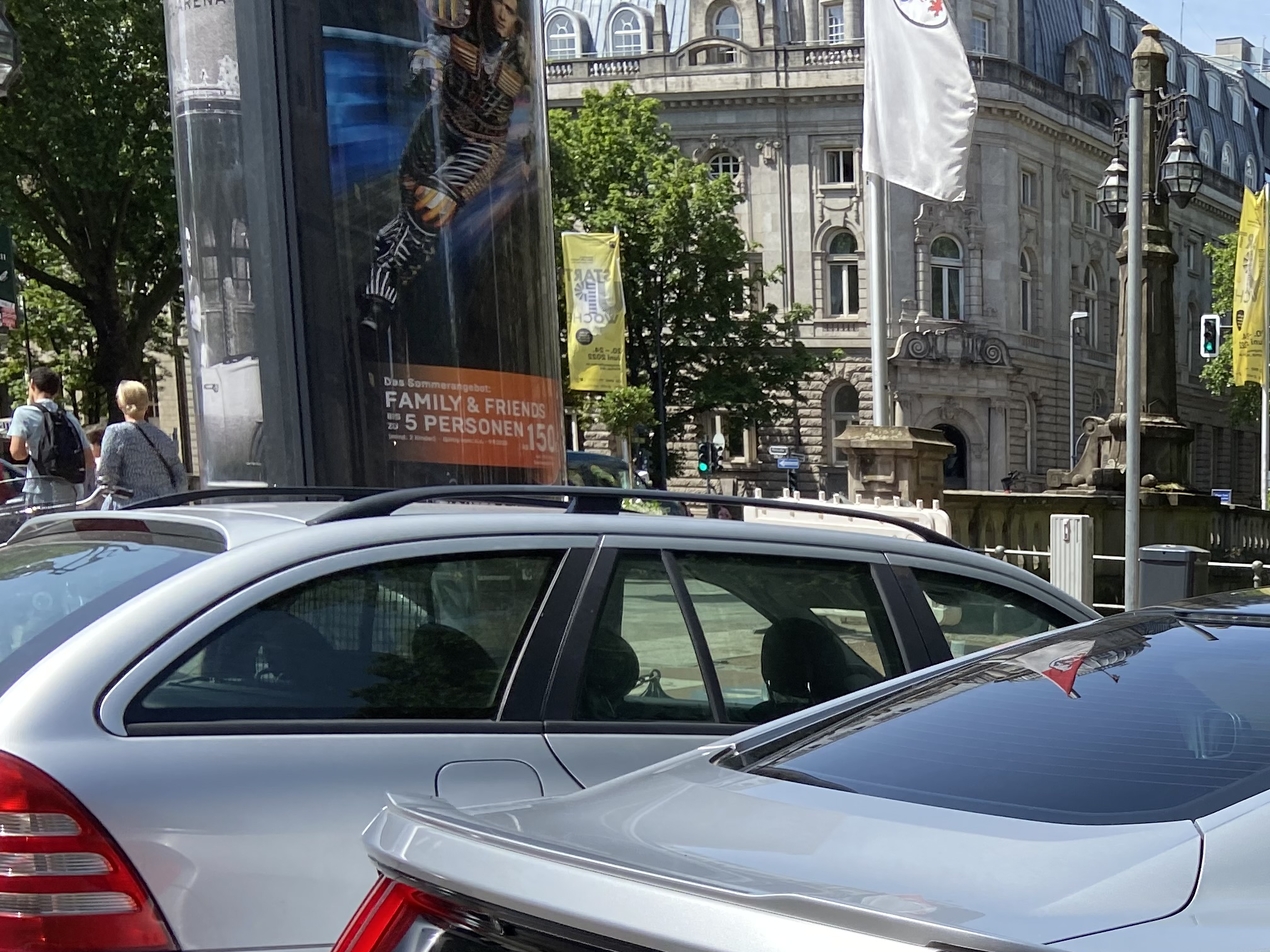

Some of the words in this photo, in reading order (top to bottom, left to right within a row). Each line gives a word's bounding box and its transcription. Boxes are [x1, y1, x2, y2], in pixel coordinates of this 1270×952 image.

[384, 376, 405, 387] Das
[407, 379, 491, 393] Sommerangebot:
[385, 390, 462, 412] FAMILY
[467, 396, 480, 413] &
[485, 398, 546, 419] FRIENDS
[405, 413, 418, 431] 5
[424, 414, 524, 437] PERSONEN
